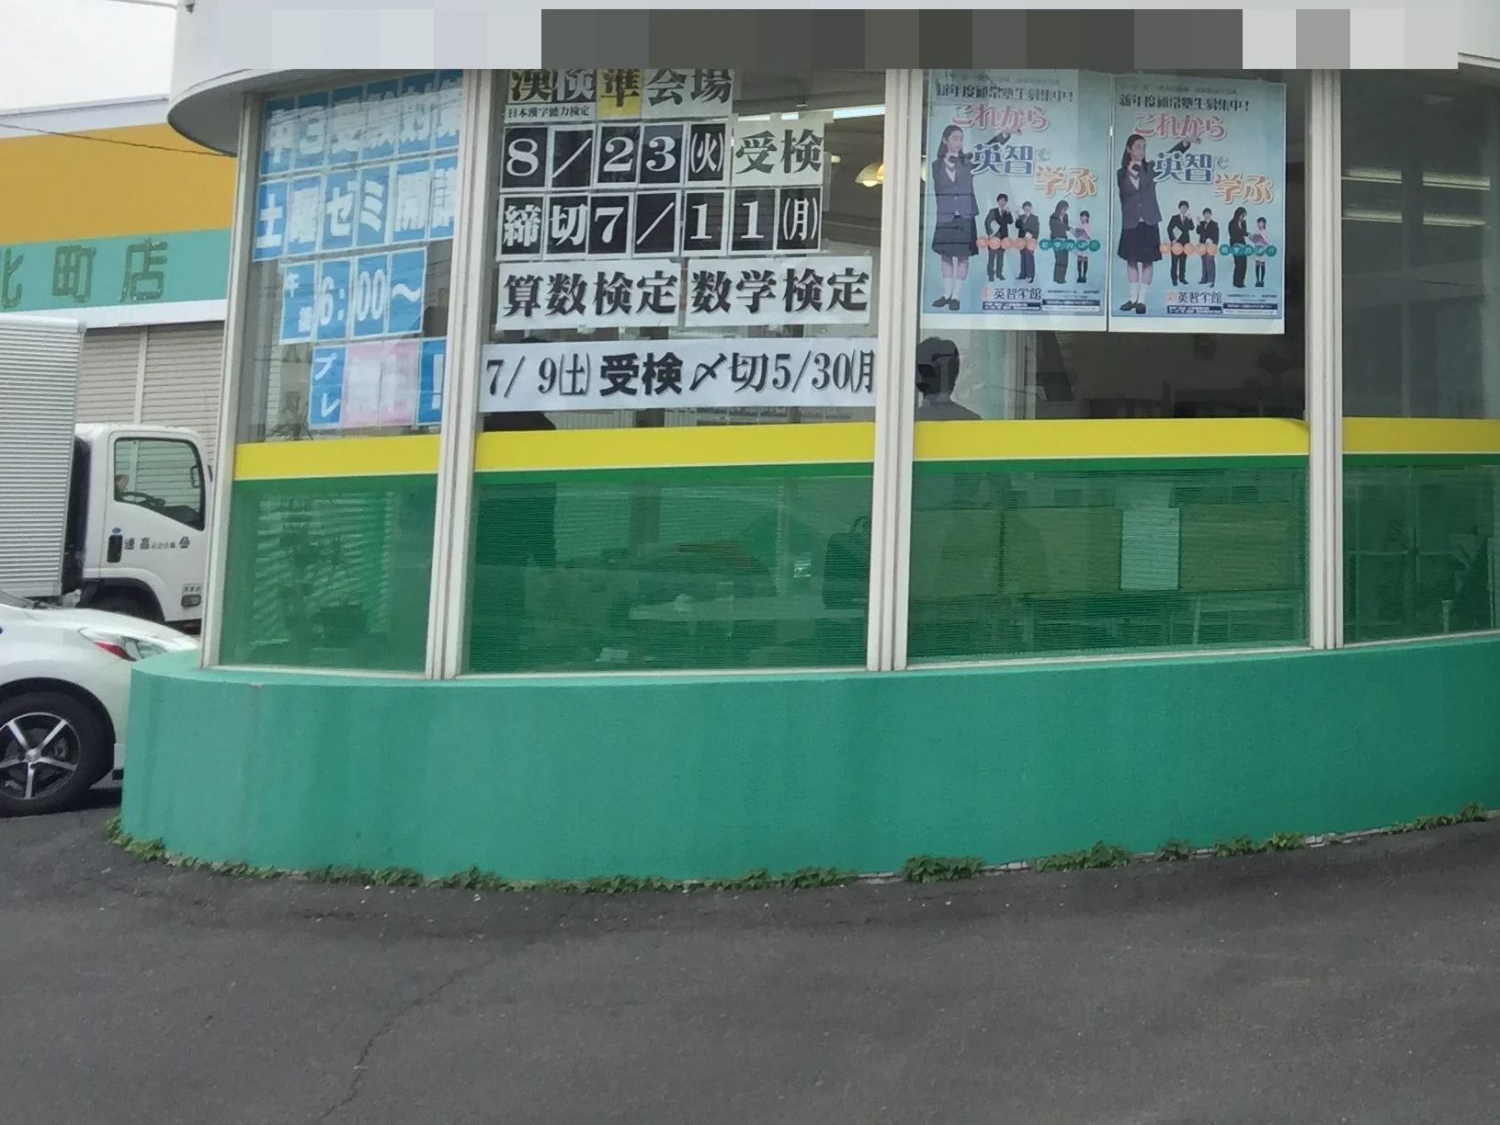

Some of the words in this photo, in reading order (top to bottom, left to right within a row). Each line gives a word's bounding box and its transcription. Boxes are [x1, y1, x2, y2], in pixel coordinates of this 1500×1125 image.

[951, 102, 1049, 132] これから
[1133, 111, 1228, 141] これから
[502, 270, 679, 319] 算数検定
[690, 267, 871, 315] 数学検定
